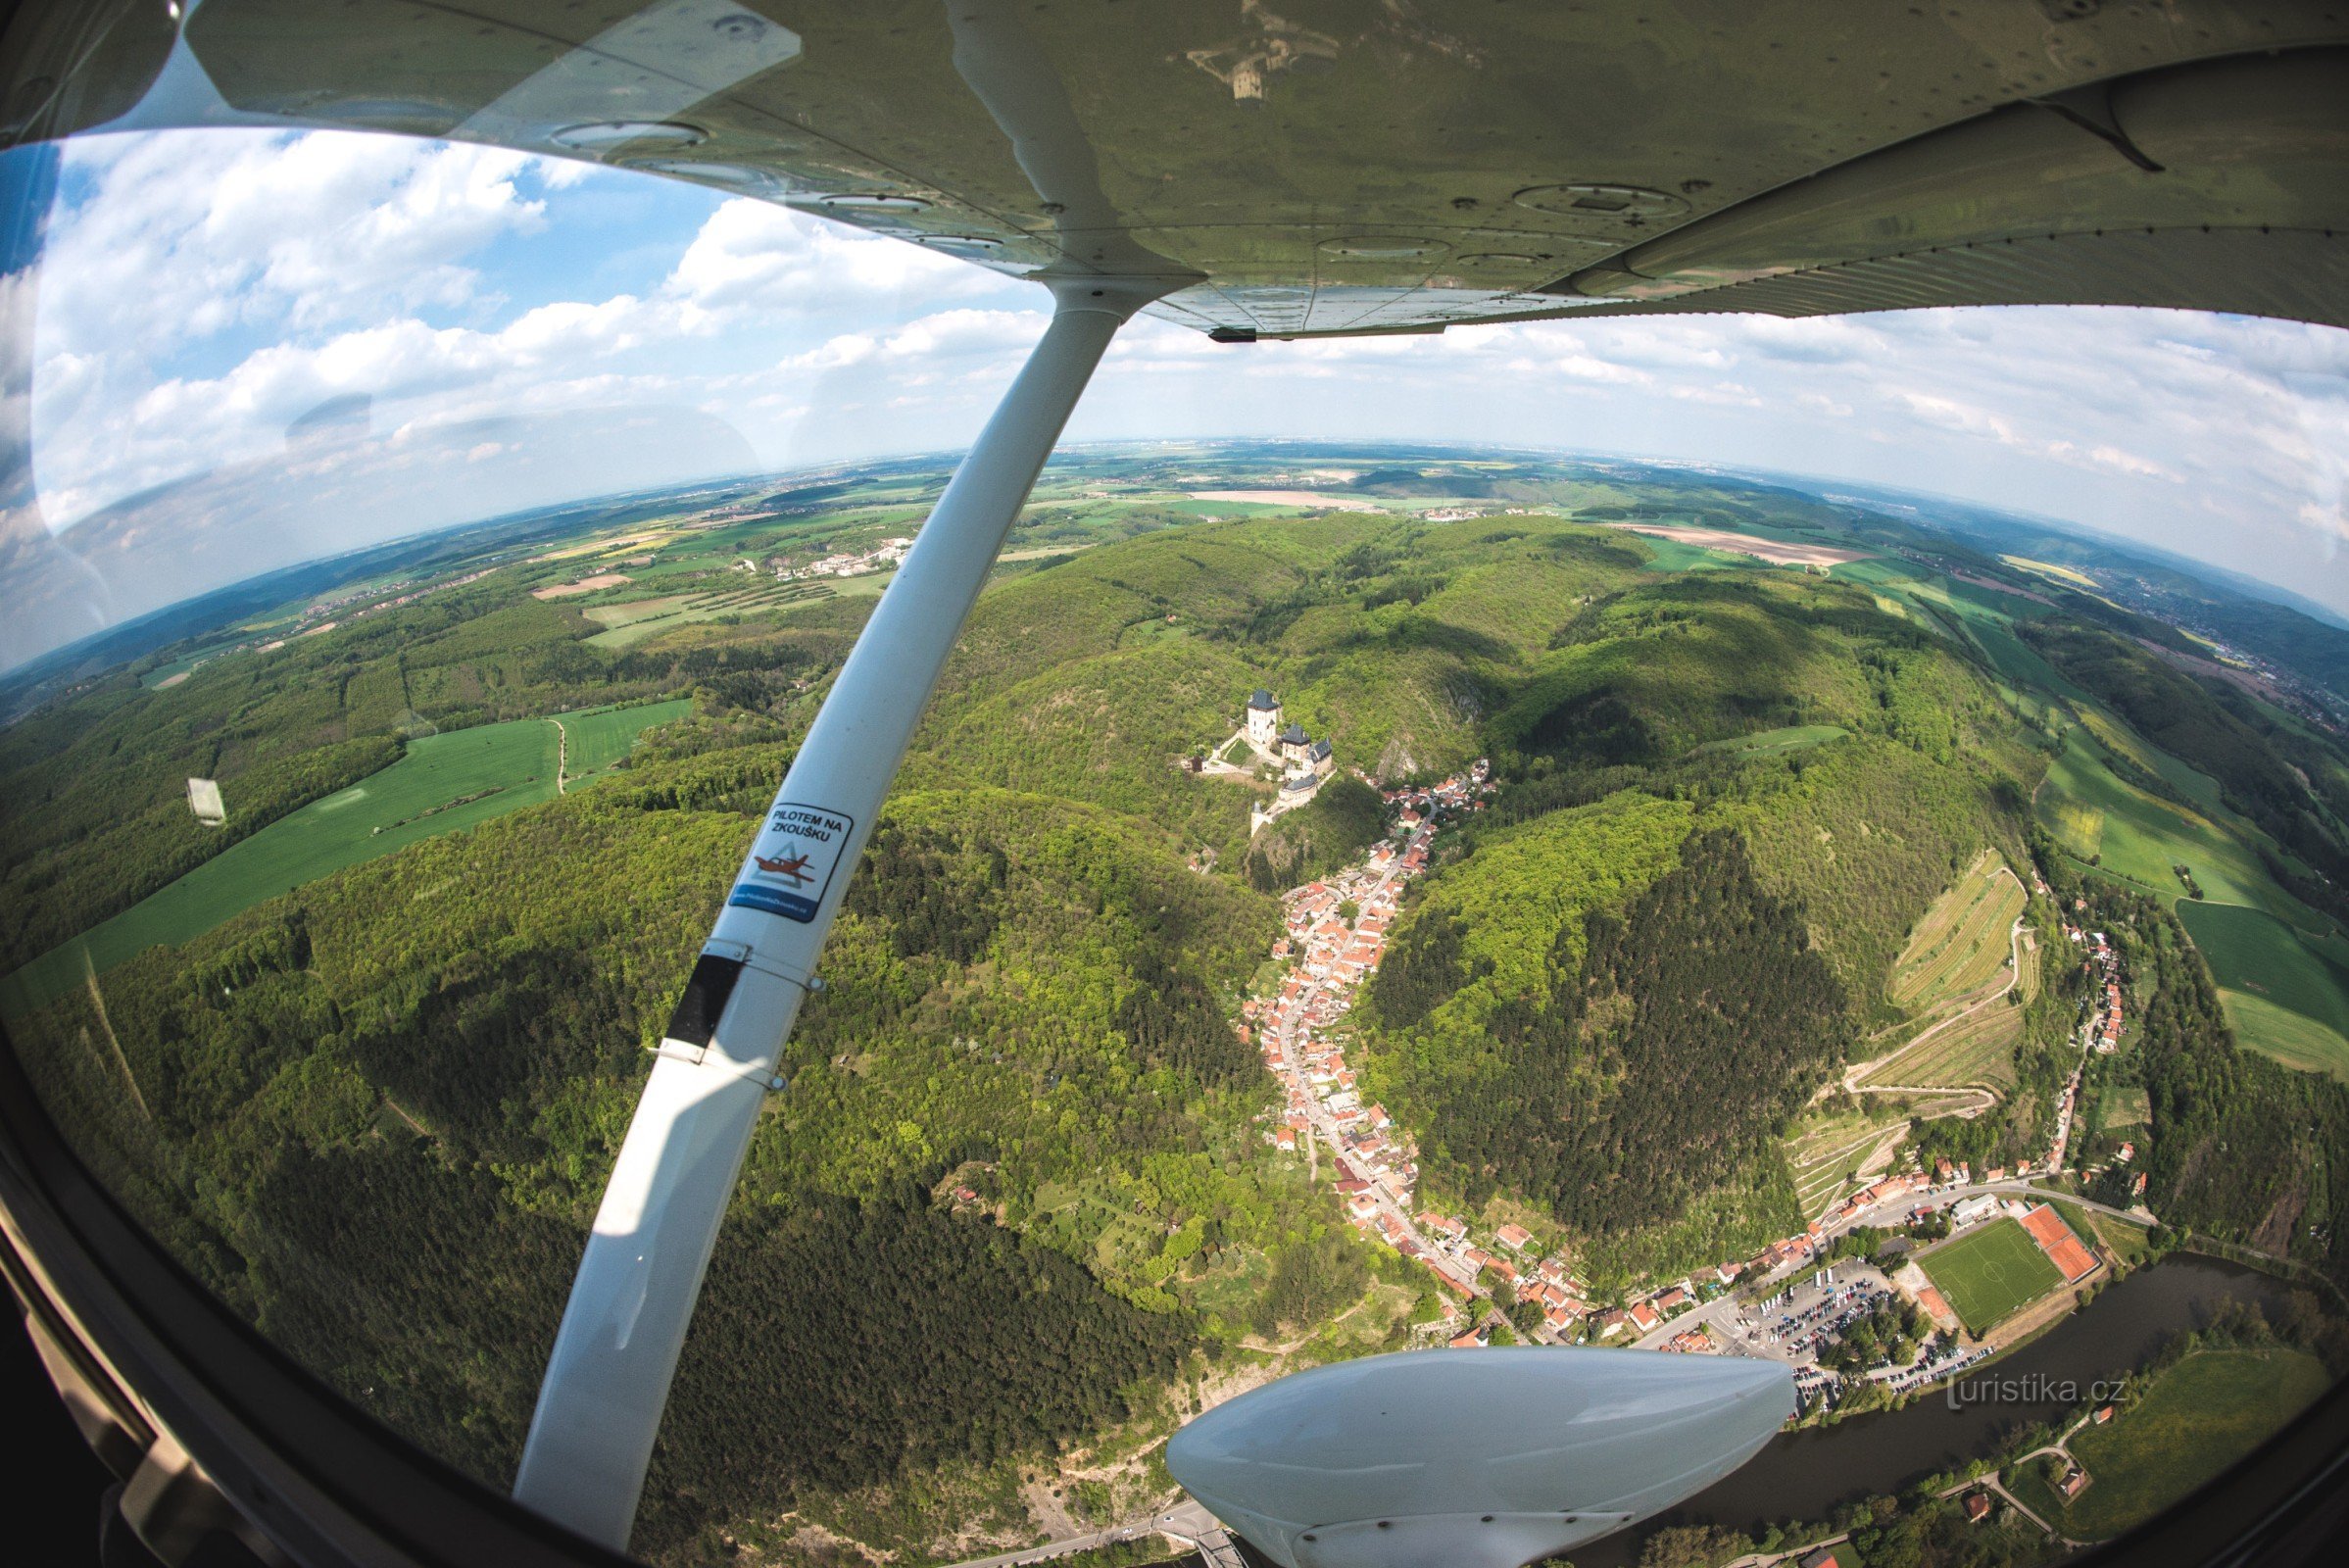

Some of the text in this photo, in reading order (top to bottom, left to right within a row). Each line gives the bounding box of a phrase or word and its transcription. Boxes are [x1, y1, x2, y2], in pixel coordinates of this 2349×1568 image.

[772, 809, 843, 833] PILOTEM NA
[771, 822, 831, 843] ZKOUŠKU
